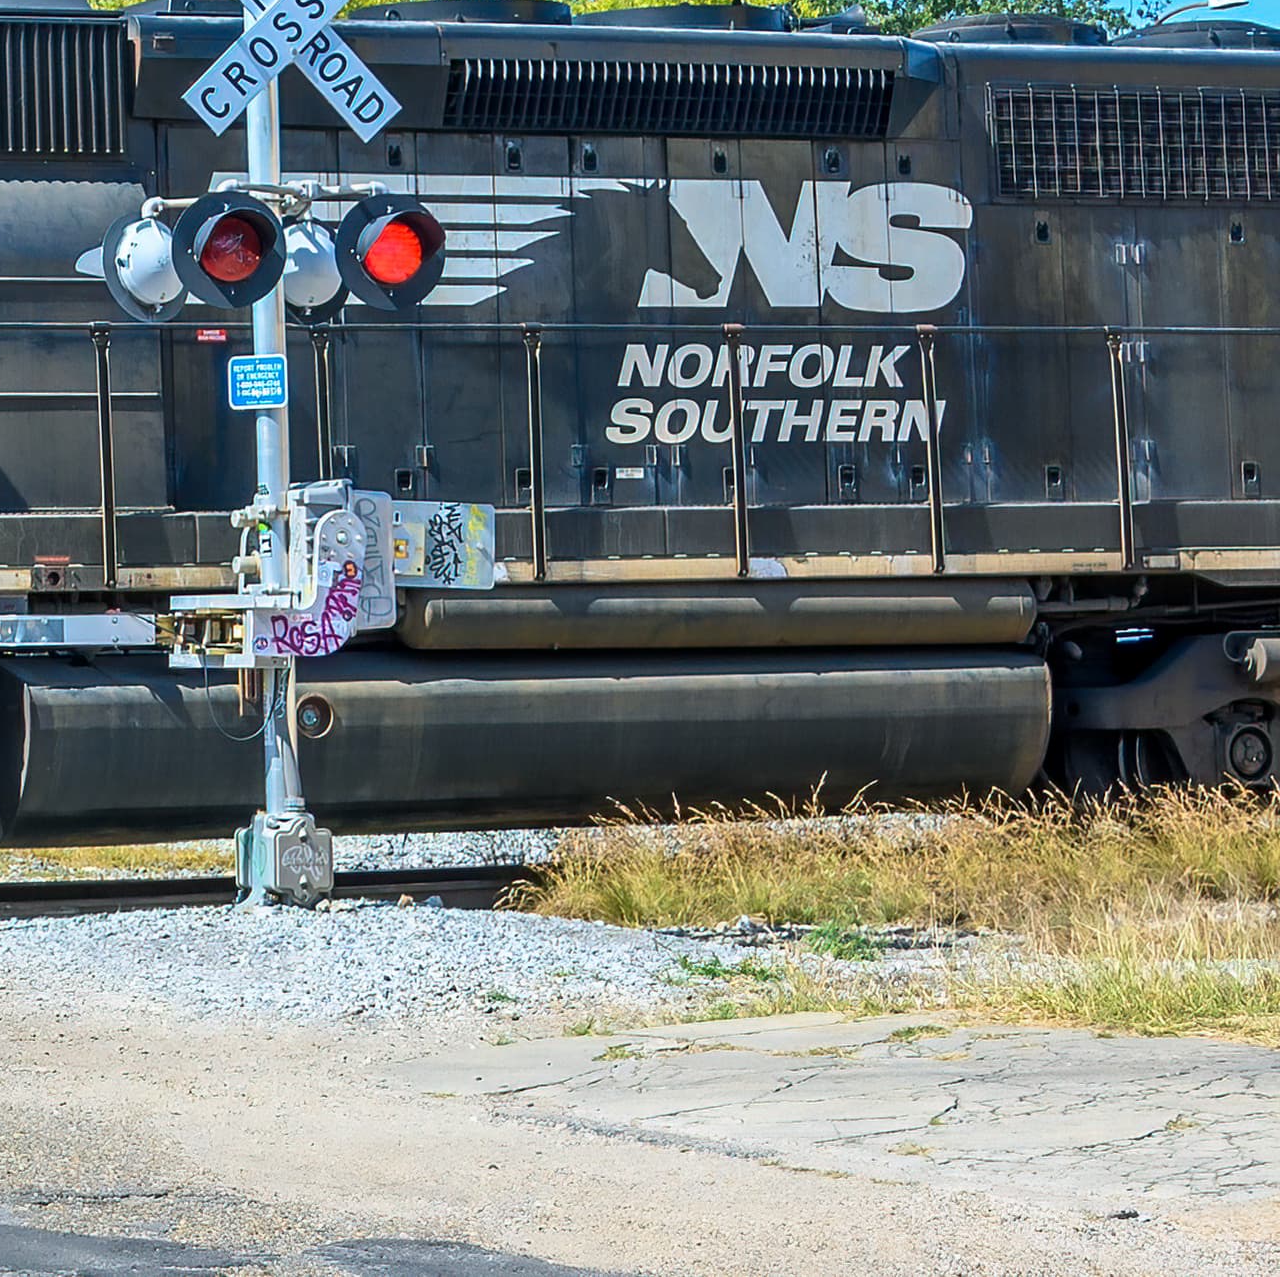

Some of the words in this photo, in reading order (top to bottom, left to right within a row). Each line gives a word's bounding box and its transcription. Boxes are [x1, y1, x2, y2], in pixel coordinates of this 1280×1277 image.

[300, 33, 385, 124] ROAD
[617, 343, 910, 389] NORFOLK
[605, 398, 946, 444] SOUTHERN
